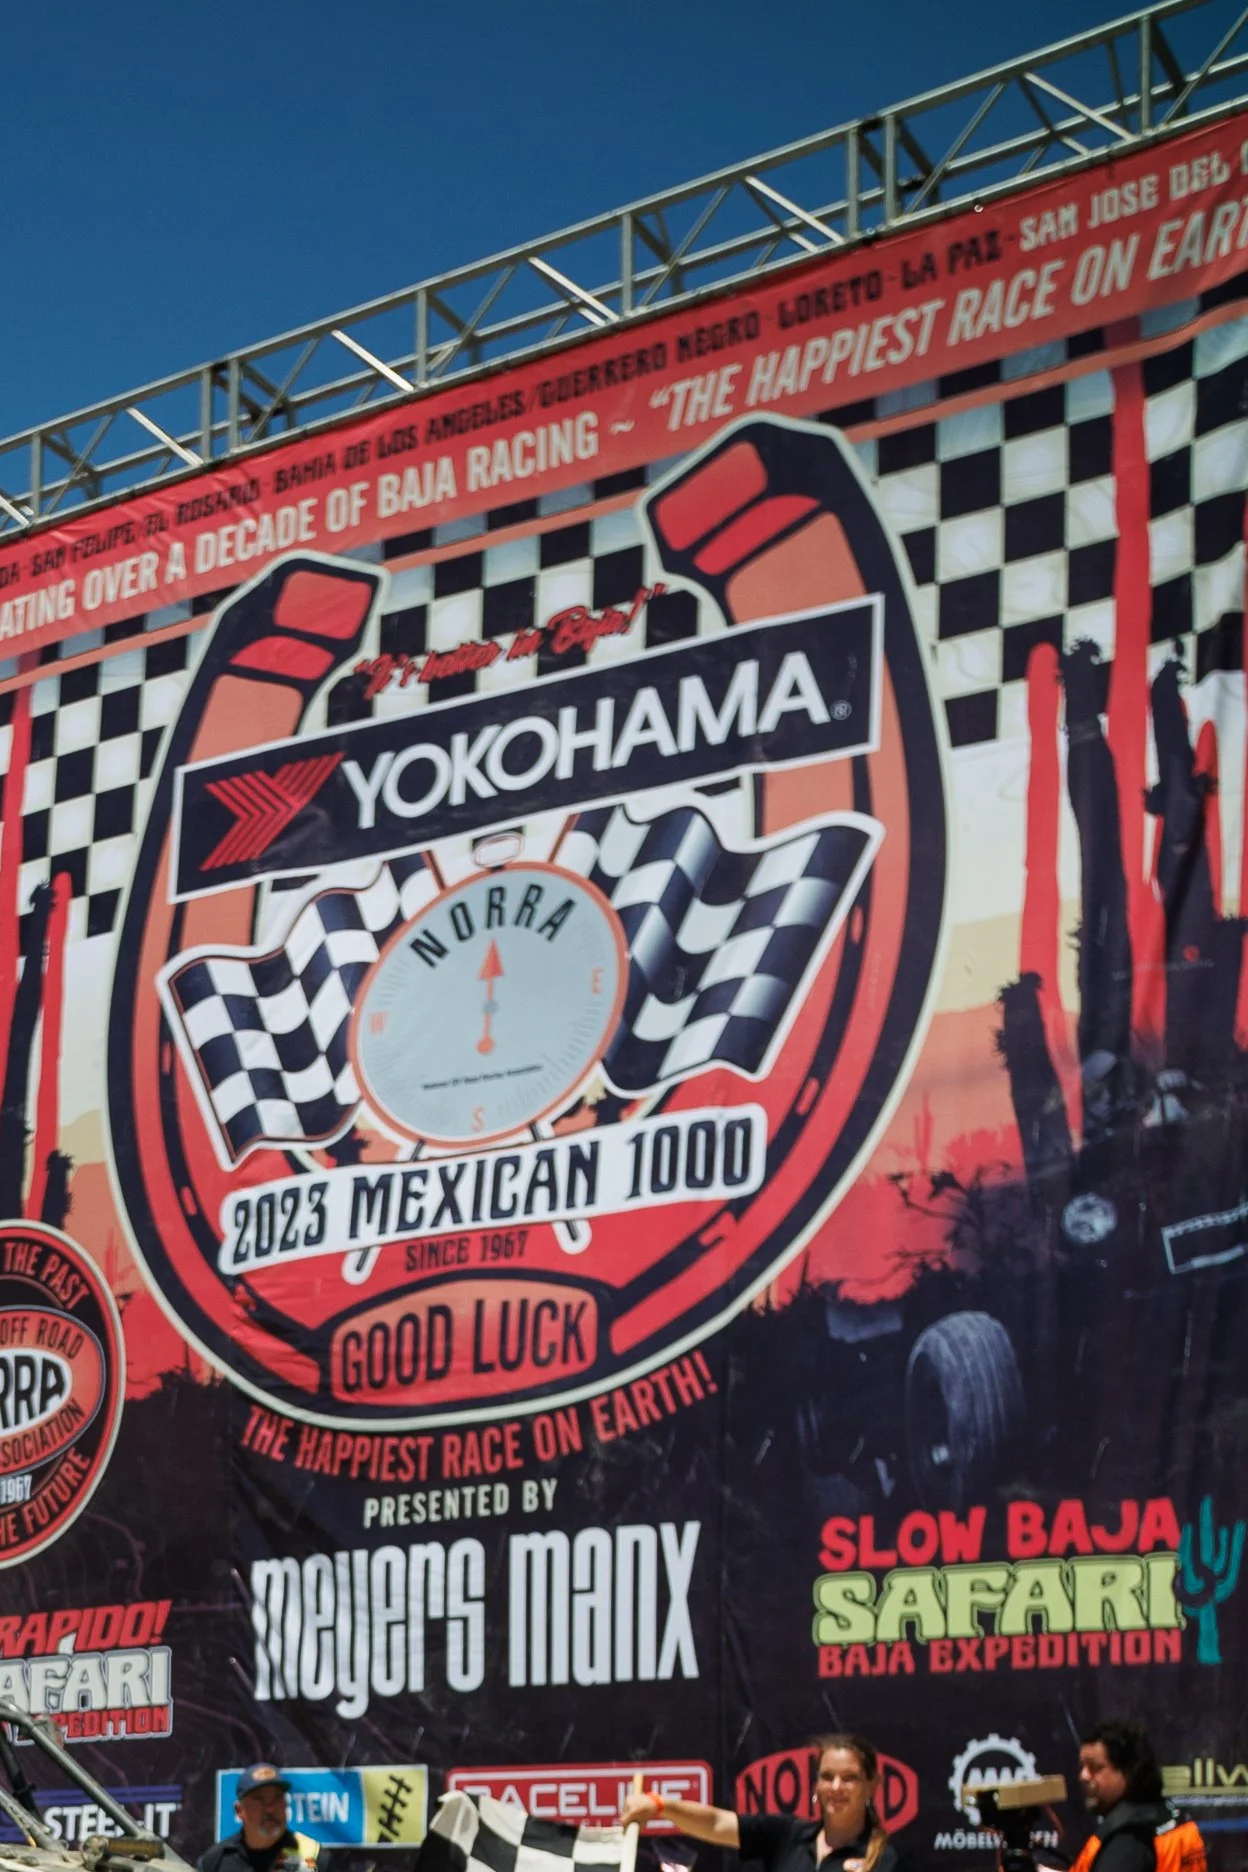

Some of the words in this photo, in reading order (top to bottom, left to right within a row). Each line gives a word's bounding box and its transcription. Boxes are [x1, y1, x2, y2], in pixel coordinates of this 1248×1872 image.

[31, 545, 67, 577] SAN
[177, 479, 260, 525] ROSARIO
[274, 452, 335, 494] BAHIA
[343, 440, 370, 469] DE
[378, 428, 419, 460] LOS
[676, 310, 760, 361] NEGRO
[778, 270, 881, 329] LORETO
[901, 251, 937, 289] LA
[947, 229, 1001, 274] PAZ
[1019, 202, 1078, 252] SAN
[1088, 174, 1160, 228] JOSE
[1169, 149, 1230, 201] DEL
[82, 551, 159, 611] OVER
[164, 542, 186, 584] A
[194, 497, 318, 575] DECADE
[325, 480, 370, 533] OF
[377, 455, 458, 520] BAJA
[466, 410, 599, 493] RACING
[745, 298, 945, 406] HAPPIEST
[947, 258, 1067, 347] RACE
[1070, 233, 1141, 307] ON
[342, 650, 831, 830] YOKOHAMA
[410, 883, 577, 969] NORRA
[471, 1106, 485, 1132] S
[233, 1181, 330, 1266] 2023
[348, 1138, 602, 1240] MEXICAN
[626, 1118, 751, 1201] 1000
[4, 1242, 42, 1275] THE
[40, 1249, 90, 1310] PAST
[404, 1237, 469, 1273] SINCE
[480, 1230, 529, 1265] 1967
[0, 1316, 28, 1346] OFF
[36, 1319, 84, 1361] ROAD
[342, 1305, 451, 1393] GOOD
[471, 1296, 588, 1376] LUCK
[241, 1407, 288, 1462] THE
[297, 1431, 434, 1482] HAPPIEST
[441, 1423, 523, 1480] RACE
[533, 1407, 582, 1462] ON
[593, 1350, 719, 1442] EARTH!
[0, 1475, 33, 1502] 1967
[24, 1448, 91, 1534] FUTURE
[363, 1484, 510, 1528] PRESENTED
[522, 1478, 558, 1512] BY
[819, 1506, 987, 1572] SLOW
[1007, 1498, 1180, 1558] BAJA
[813, 1552, 1186, 1646] SAFARI
[819, 1641, 915, 1678] BAJA
[929, 1628, 1182, 1673] EXPEDITION
[20, 1705, 170, 1740] PEDITION
[43, 1803, 177, 1843] STEEIT
